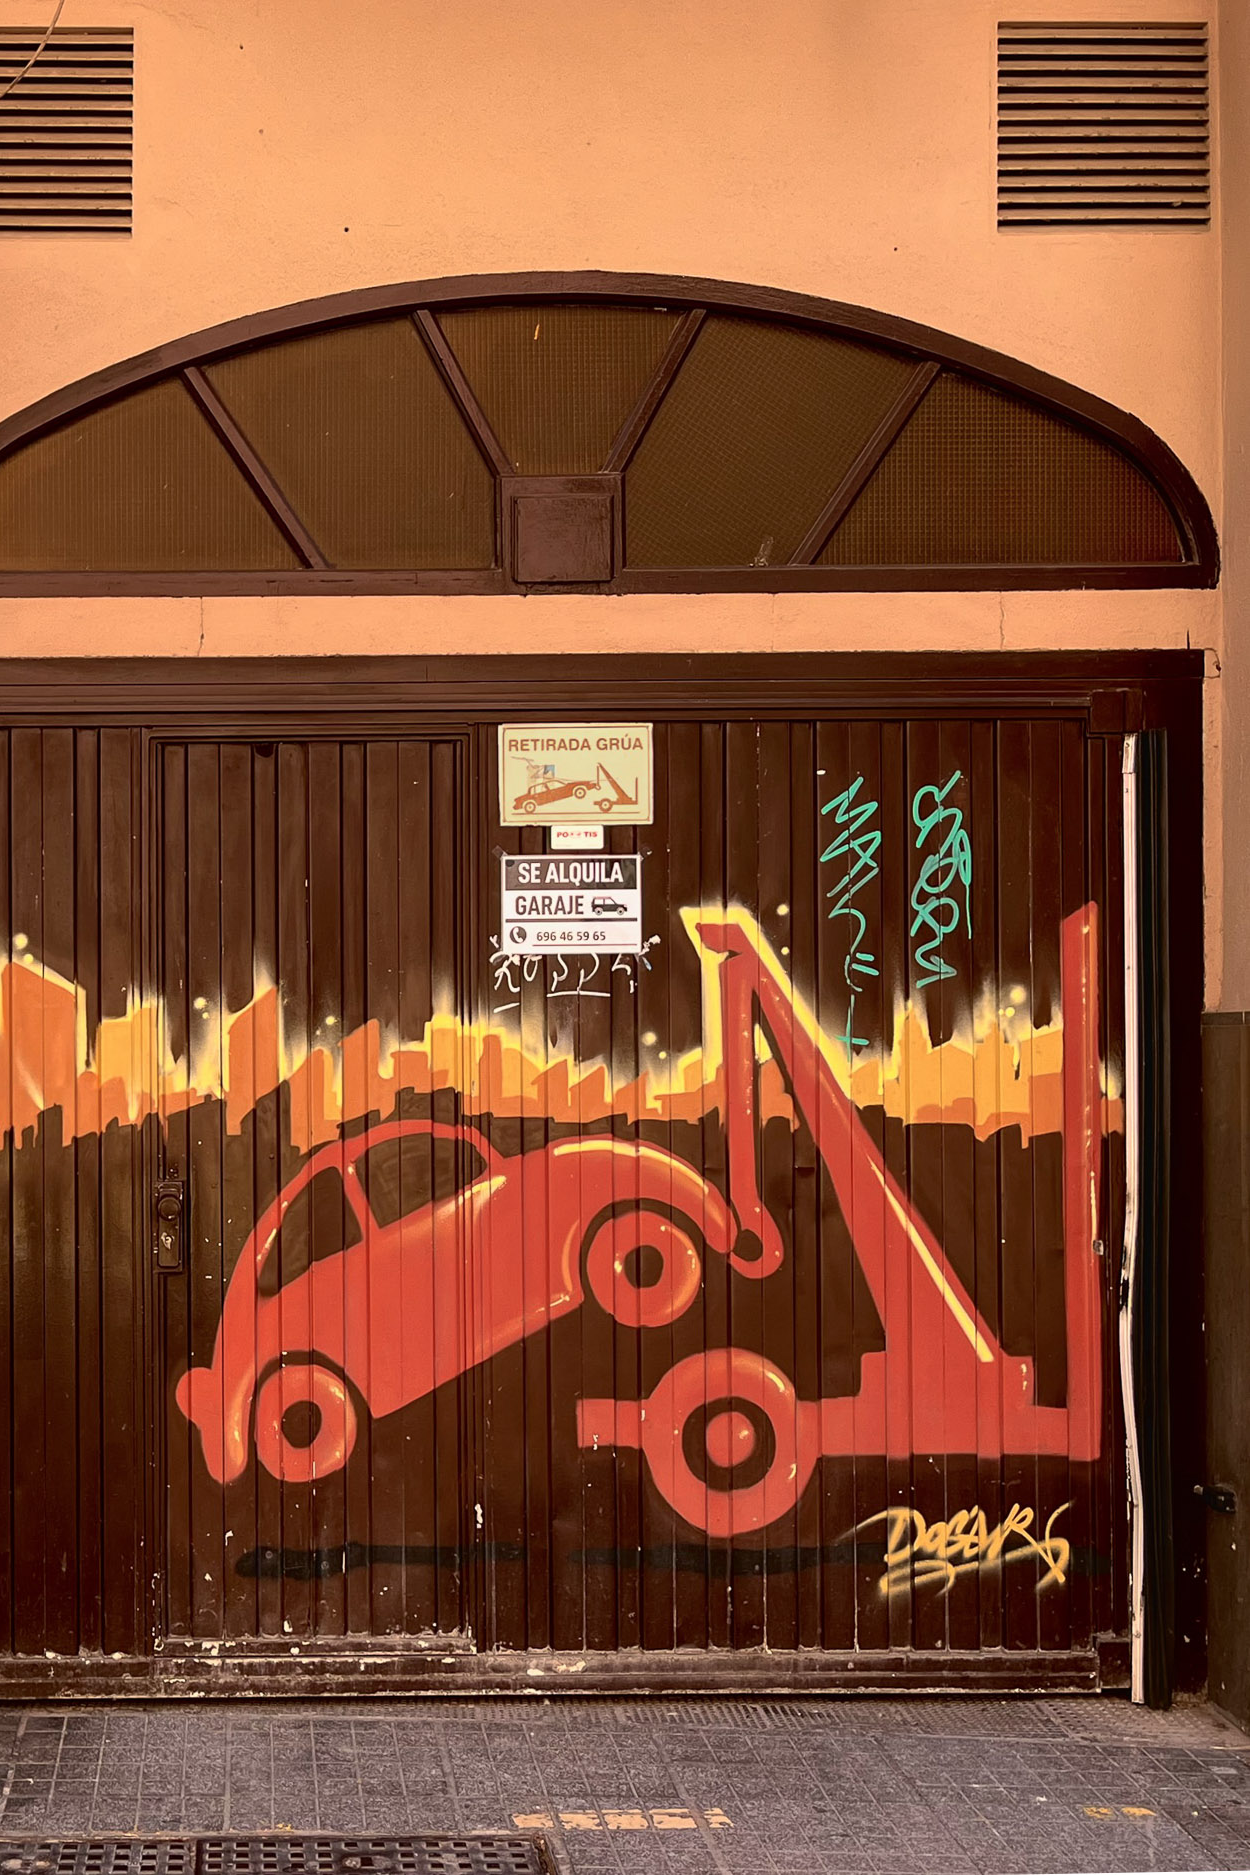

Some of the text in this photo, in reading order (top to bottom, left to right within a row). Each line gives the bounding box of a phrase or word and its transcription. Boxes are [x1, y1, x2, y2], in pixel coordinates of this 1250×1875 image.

[508, 733, 644, 752] RETIRADA GRÚA
[518, 862, 624, 887] SE ALQUILA
[515, 895, 584, 916] GARAJE
[536, 931, 606, 942] 696 46 59 65
